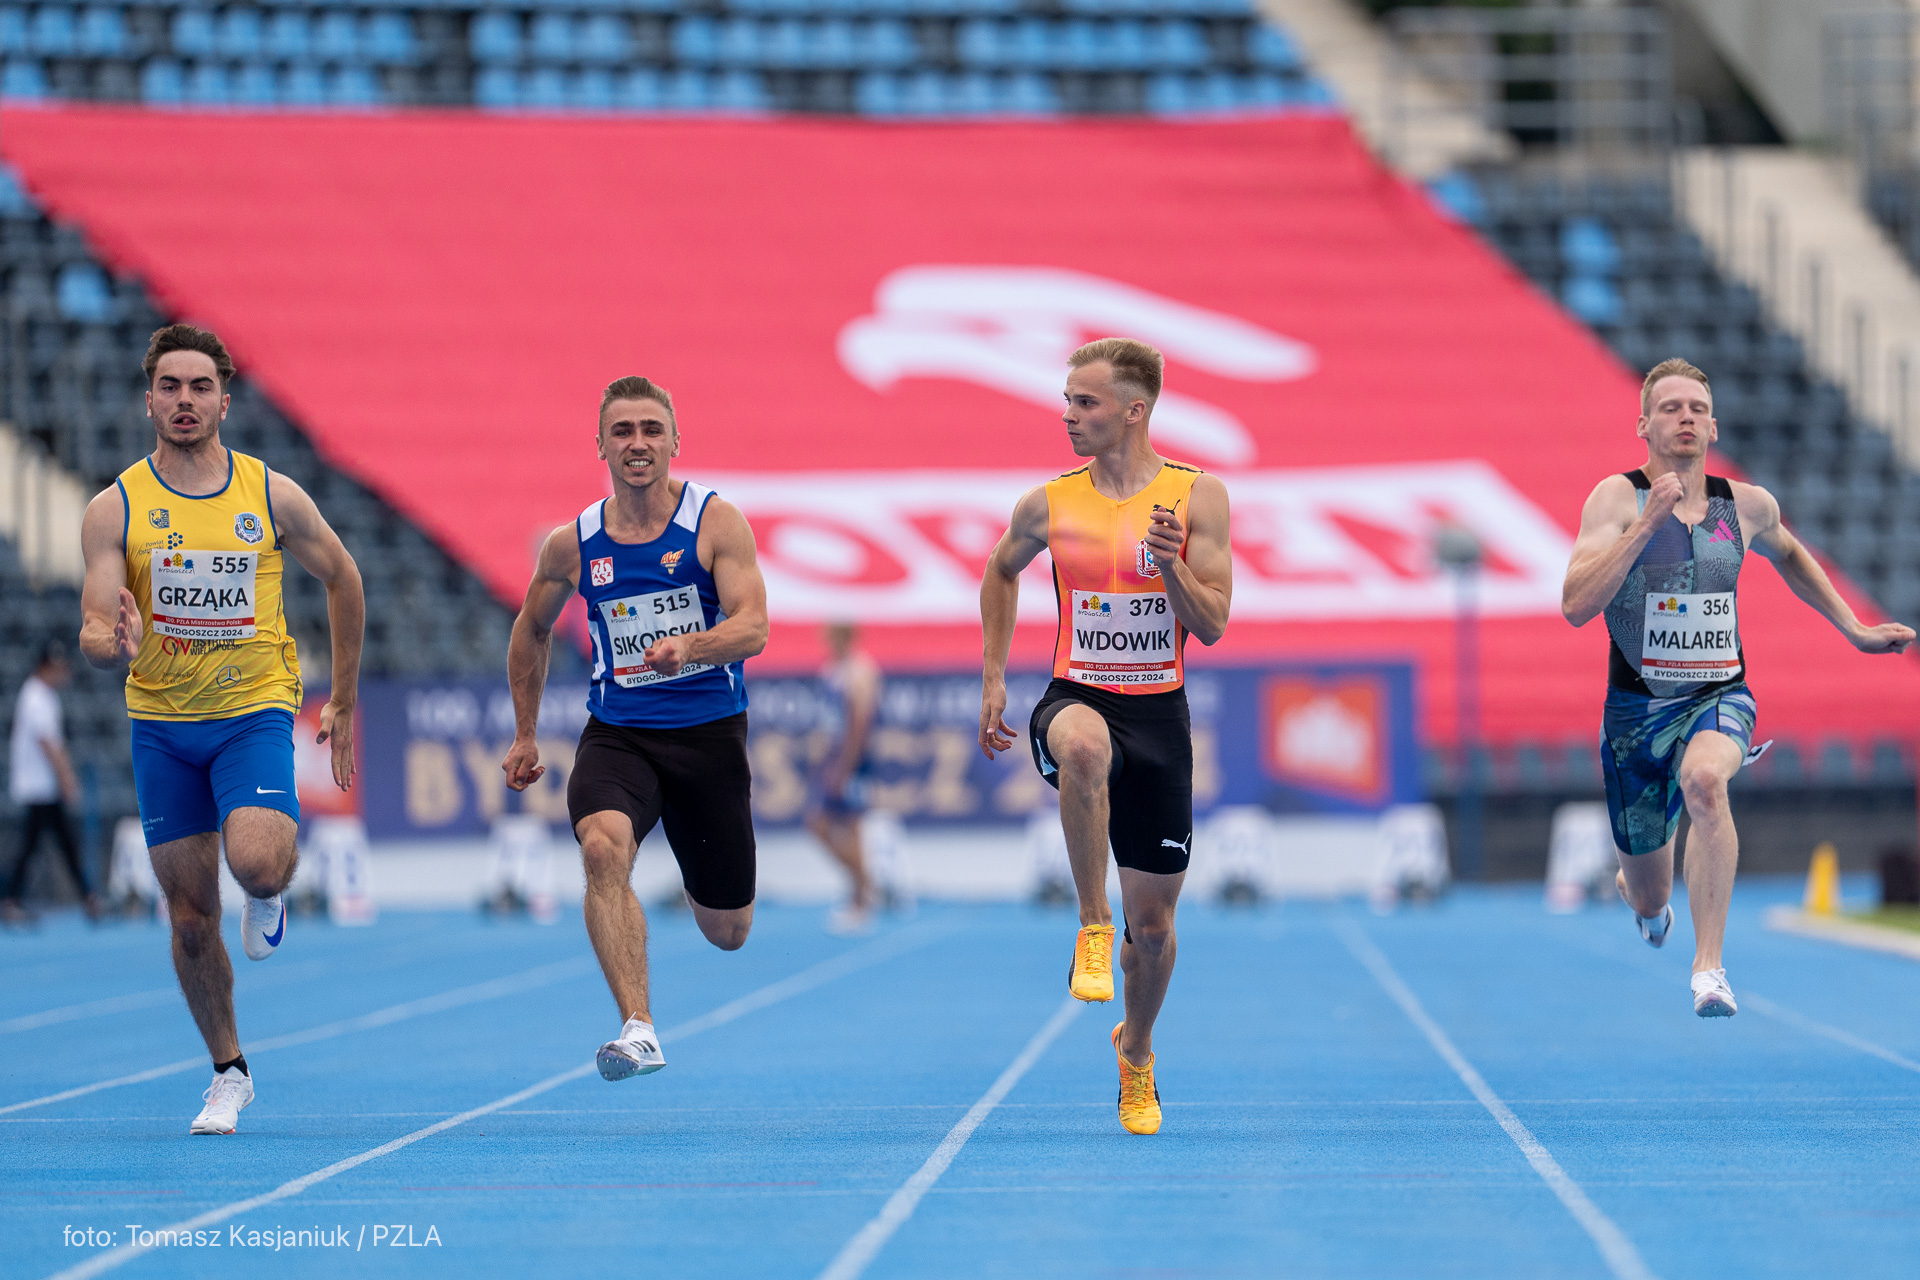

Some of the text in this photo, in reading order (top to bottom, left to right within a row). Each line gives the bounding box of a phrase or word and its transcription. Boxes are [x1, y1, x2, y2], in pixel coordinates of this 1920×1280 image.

[757, 504, 1530, 584] OREN
[211, 556, 249, 574] 555
[158, 586, 249, 612] GRZĄKA
[653, 592, 691, 615] 515
[1129, 597, 1166, 617] 378
[1703, 598, 1730, 616] 356
[226, 618, 243, 626] Polski
[164, 626, 243, 637] BYDGOSZCZ 2024
[1076, 629, 1171, 652] WDOWIK
[1648, 629, 1732, 650] MALAREK
[680, 664, 702, 675] 2024
[1654, 669, 1729, 679] BYDGOSZCZ 2024
[1682, 661, 1714, 669] Mistrzostwa
[1081, 673, 1165, 682] BYDGOSZCZ 2024
